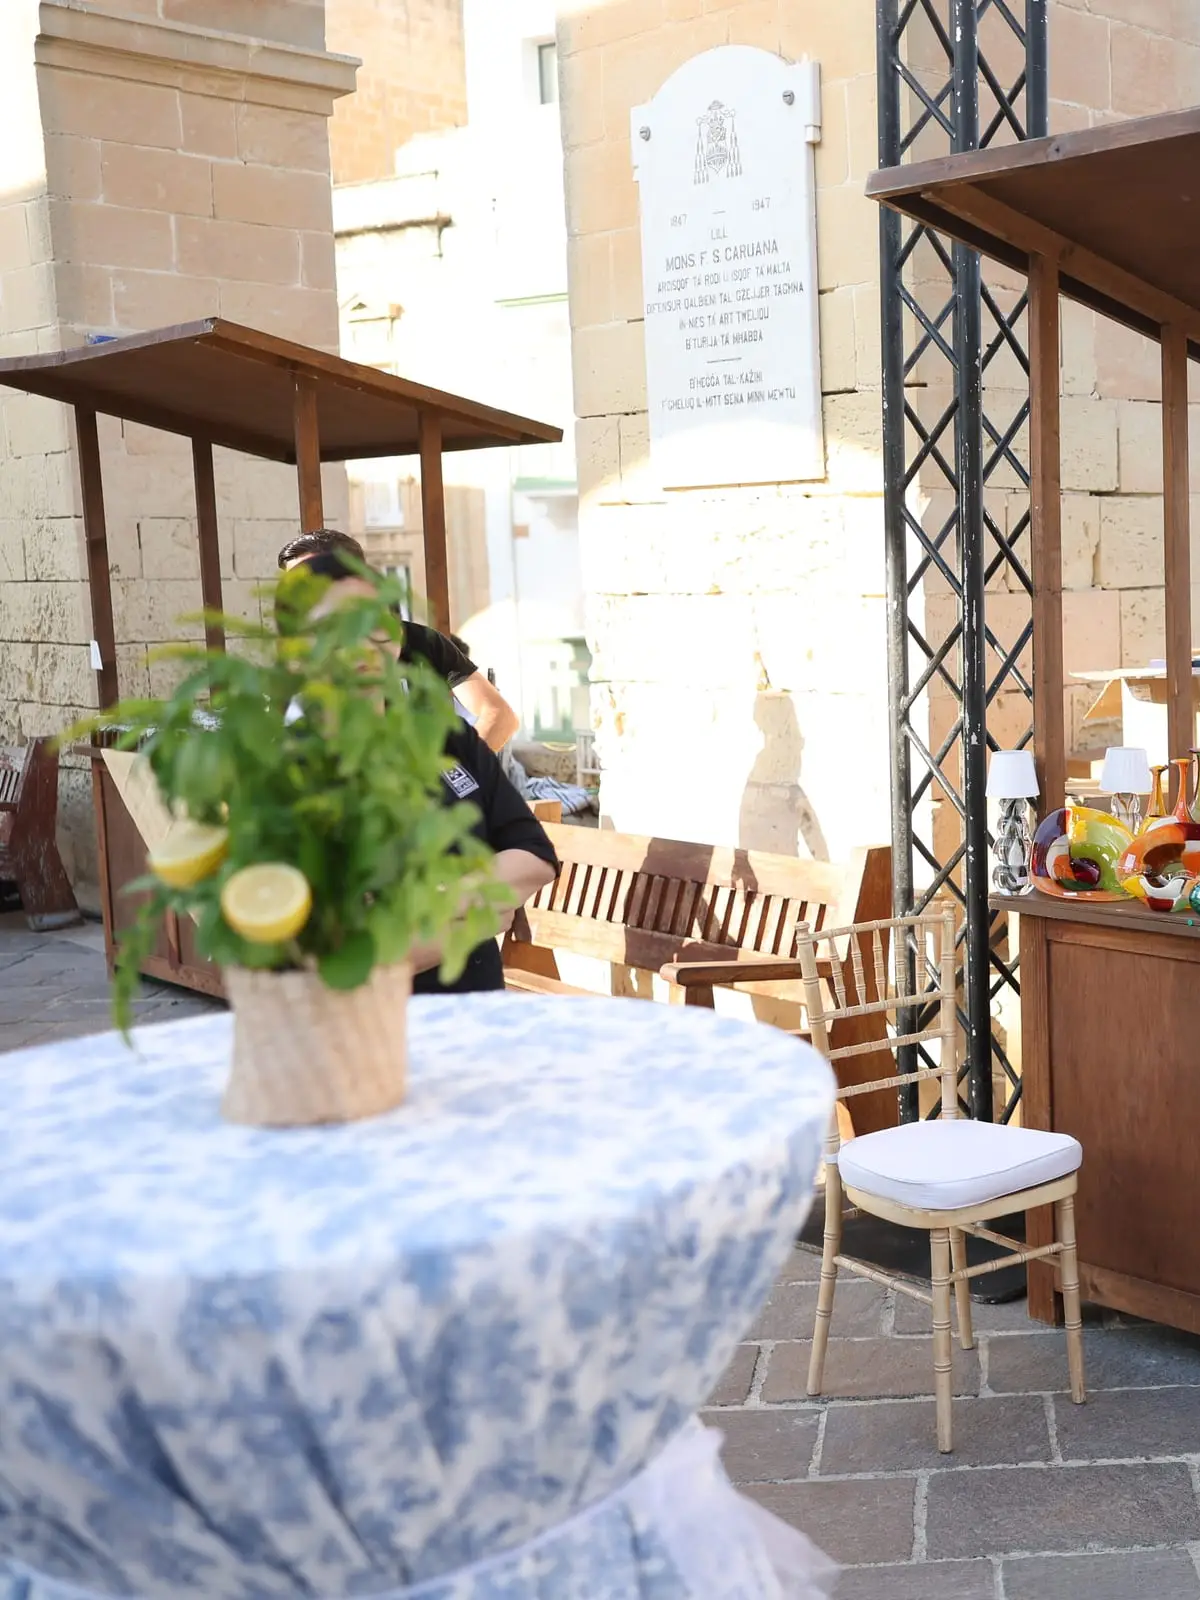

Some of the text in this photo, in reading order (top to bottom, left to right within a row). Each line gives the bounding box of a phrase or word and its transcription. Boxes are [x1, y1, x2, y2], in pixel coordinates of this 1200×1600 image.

[752, 197, 771, 212] 1947
[724, 238, 779, 262] CARUANA
[766, 260, 791, 276] MALTA
